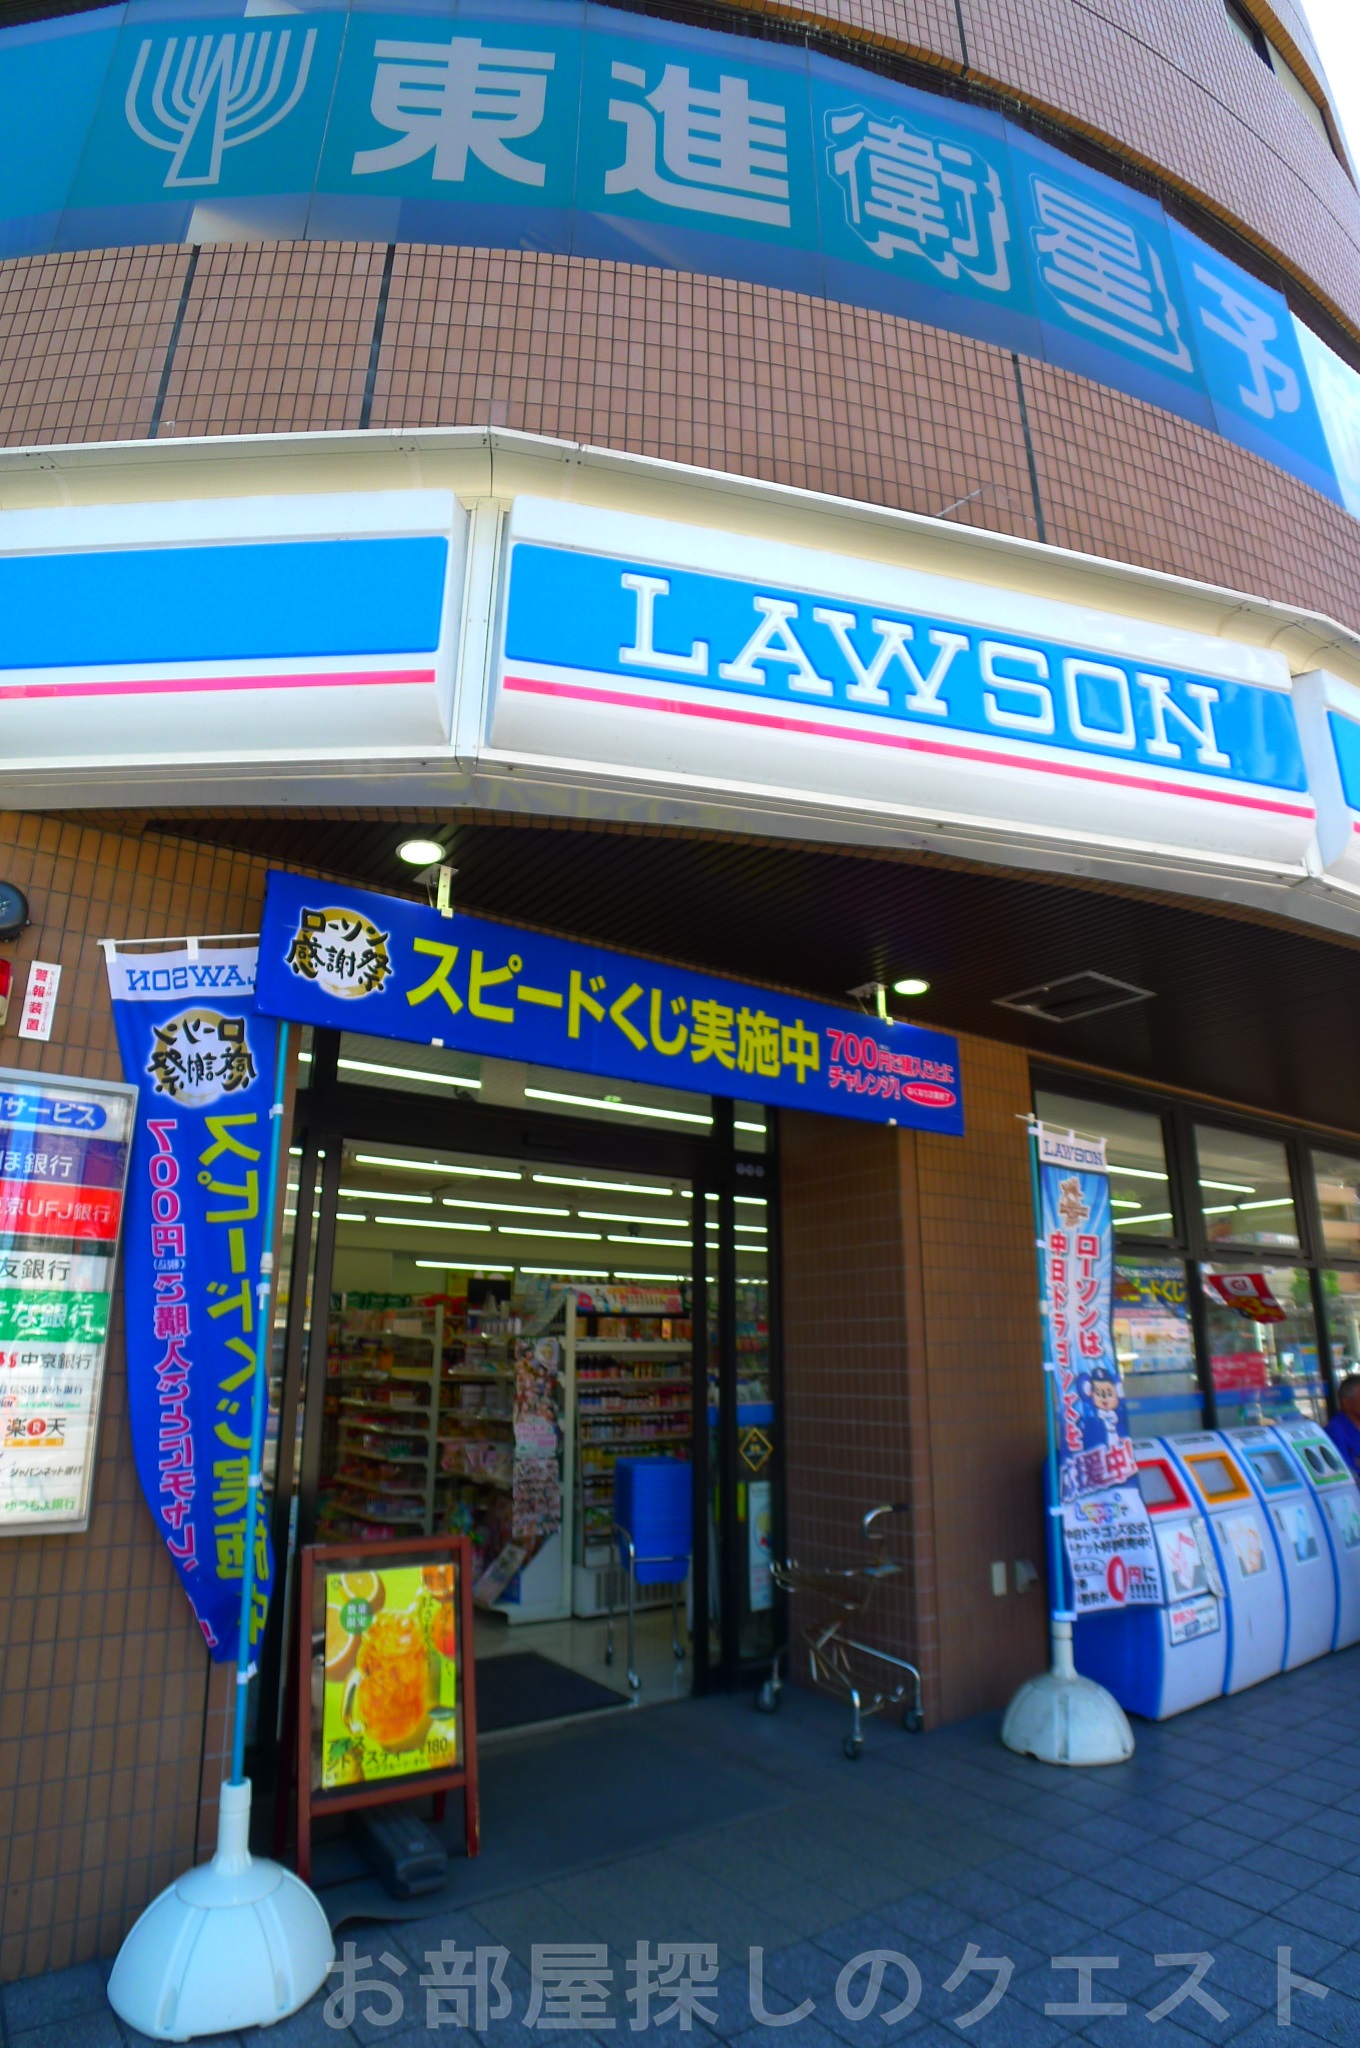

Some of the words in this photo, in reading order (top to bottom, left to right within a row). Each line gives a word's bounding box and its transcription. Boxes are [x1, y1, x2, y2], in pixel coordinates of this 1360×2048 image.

[351, 37, 1360, 482] 東進衛星予
[618, 572, 1232, 768] LAWSON
[301, 907, 390, 947] ローソン
[285, 937, 394, 993] 感謝祭
[26, 968, 49, 1031] 警報装置
[405, 937, 821, 1086] スピードくじ実施中
[0, 1095, 97, 1127] サービス
[0, 1149, 73, 1179] ほ銀行
[1043, 1139, 1104, 1167] LAWSON
[1075, 1233, 1104, 1358] ローソンは
[21, 1351, 93, 1370] 中京銀行
